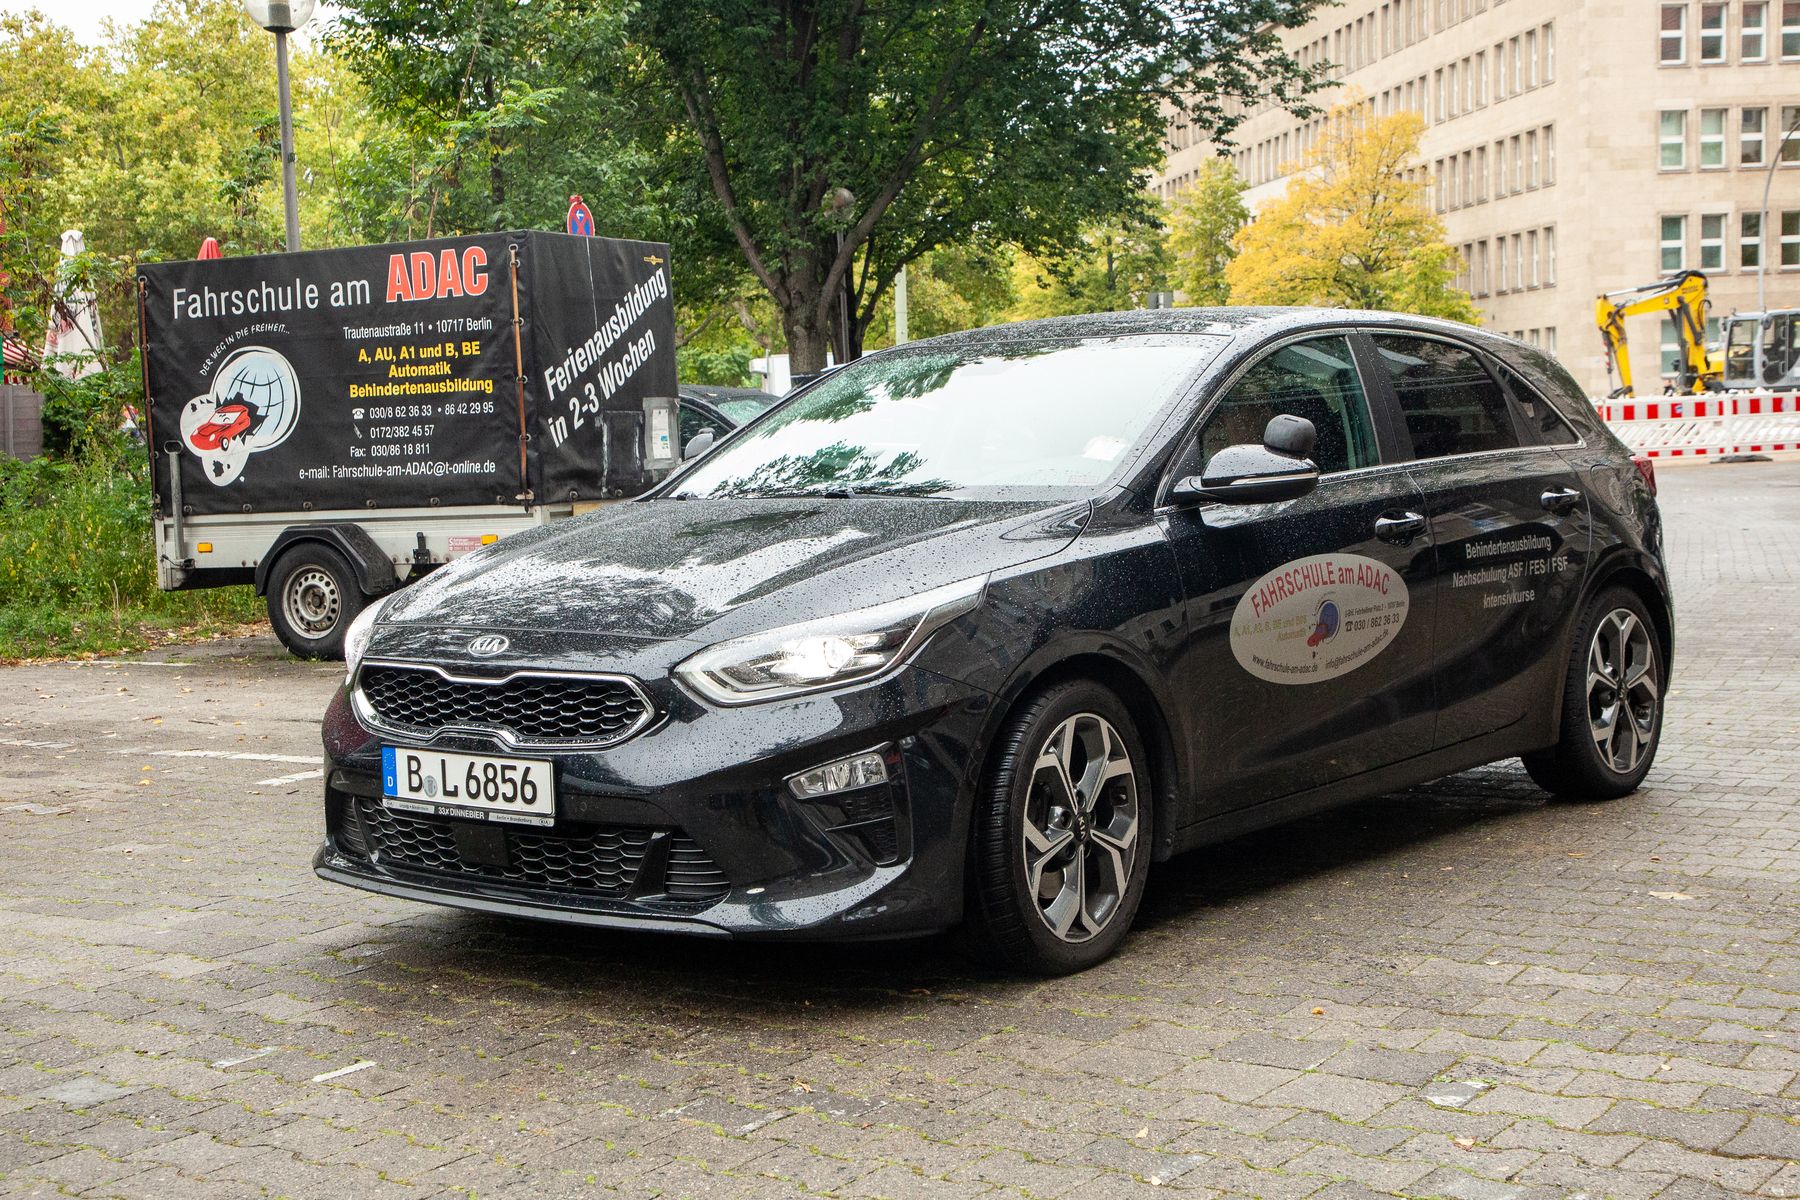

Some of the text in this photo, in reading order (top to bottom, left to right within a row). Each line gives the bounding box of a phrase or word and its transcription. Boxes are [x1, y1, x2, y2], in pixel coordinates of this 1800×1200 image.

[173, 246, 489, 319] Fahrschule am ADAC
[343, 317, 492, 340] Trautenaustraße 11 10717 Berlin
[543, 267, 668, 401] Ferienausbildung
[200, 359, 214, 376] DER
[210, 342, 227, 359] WEG
[225, 335, 235, 345] IN
[235, 327, 249, 339] DIE
[358, 341, 481, 364] A, AU, A1 und B, BE
[388, 361, 452, 378] Automatik
[350, 378, 493, 398] Behindertenausbildung
[548, 328, 656, 448] in 2-3 Wochen
[369, 402, 494, 419] 030/8 62 36 33 86 42 29 95
[370, 425, 435, 439] 0172/382 45 57
[350, 443, 430, 458] Fax: 030/86 18 811
[299, 460, 496, 480] e-mail: Fahrschule-am-ADAC@t-online.de
[1465, 535, 1552, 559] Behindertenausbildung
[1452, 567, 1507, 588] Nachschulung
[1508, 561, 1524, 579] ASF
[1529, 558, 1546, 575] FES
[1551, 556, 1568, 572] FSF
[1251, 561, 1336, 618] FAHRSCHULE
[1338, 566, 1355, 585] am
[1357, 563, 1390, 595] ADAC
[1483, 589, 1535, 608] Intensivkurse
[1354, 619, 1366, 631] 030
[1371, 616, 1382, 628] 862
[1383, 614, 1391, 625] 36
[1392, 612, 1399, 624] 33
[470, 637, 502, 653] KIA
[387, 776, 394, 787] D
[407, 754, 538, 805] B L 6856
[450, 807, 485, 820] DINNEBIER
